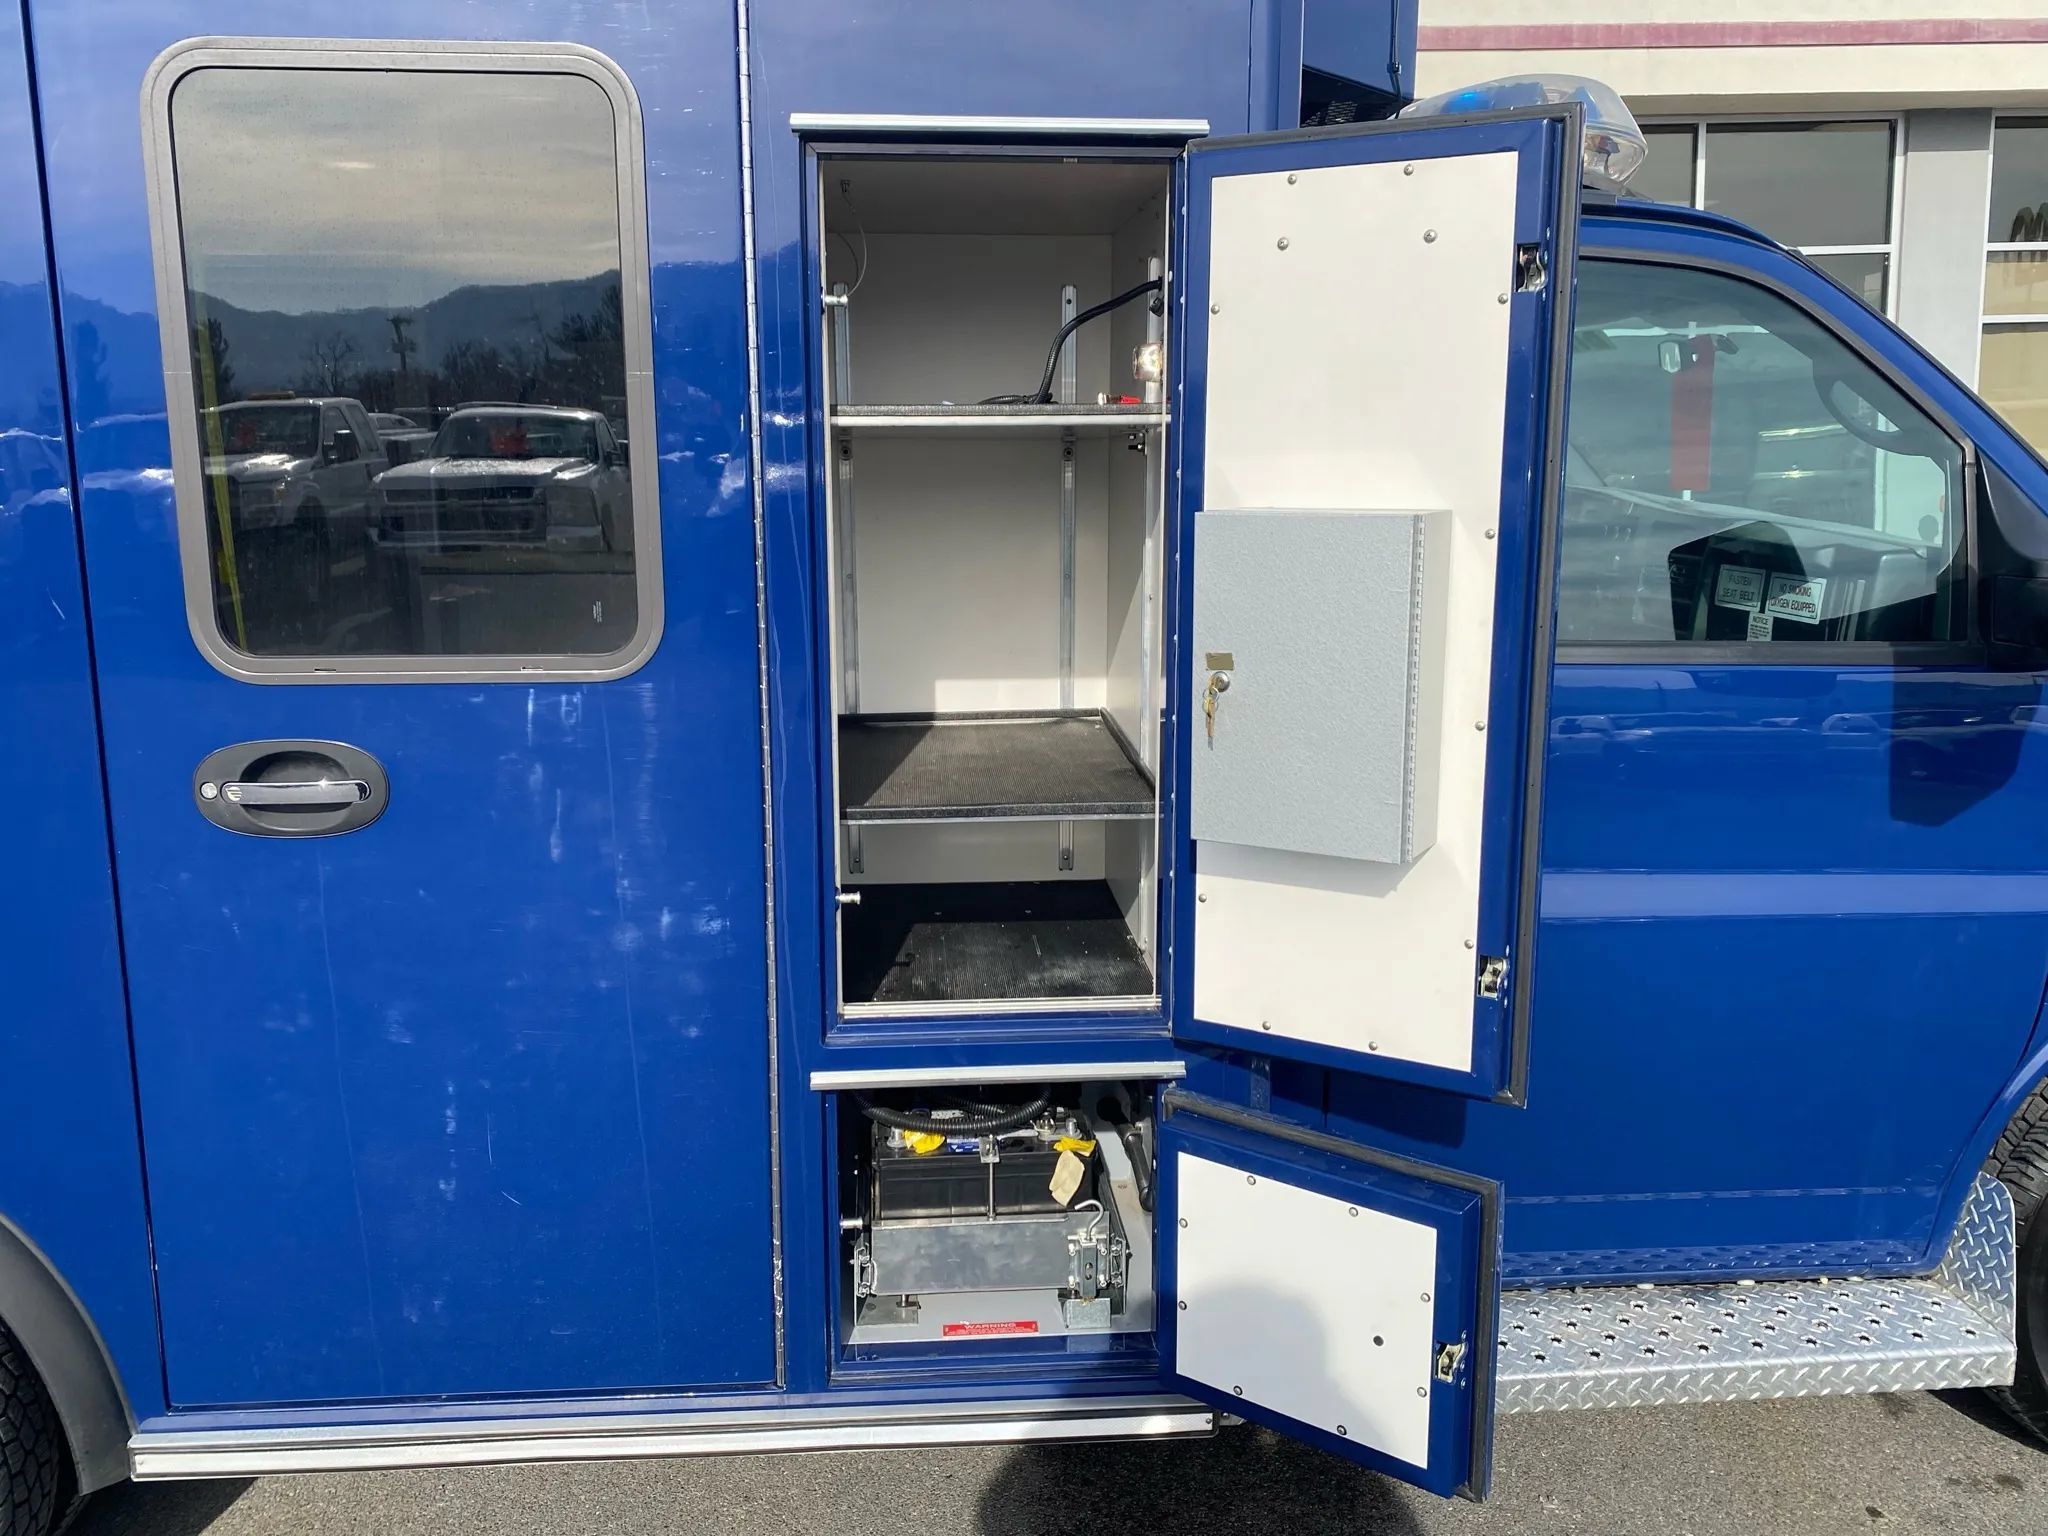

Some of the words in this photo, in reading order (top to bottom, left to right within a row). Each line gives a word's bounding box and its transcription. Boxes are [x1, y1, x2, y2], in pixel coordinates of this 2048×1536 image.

[1722, 588, 1738, 599] SEAT
[1739, 590, 1755, 601] BELT
[1779, 583, 1788, 594] NO
[1788, 584, 1812, 597] SMOKING
[1770, 597, 1790, 608] OXYGEN
[1791, 598, 1816, 613] EQUIPPED
[1752, 616, 1769, 625] NOTICE
